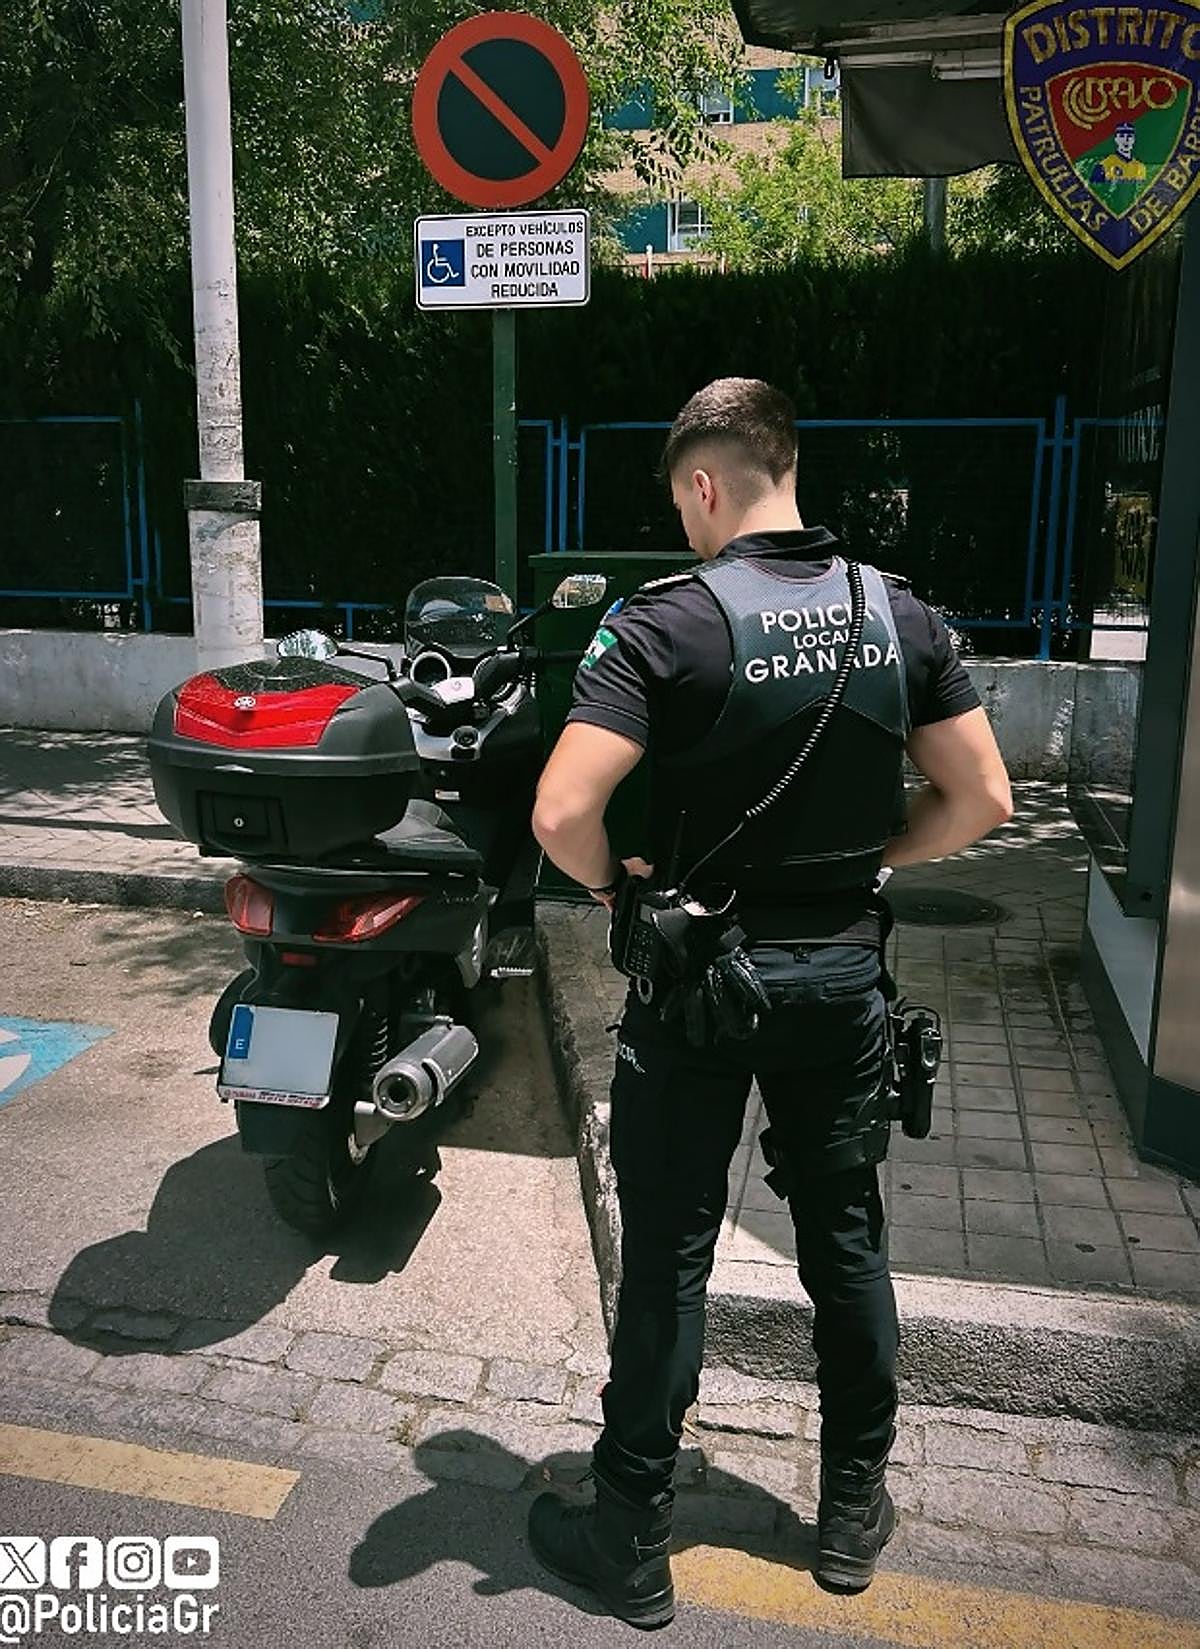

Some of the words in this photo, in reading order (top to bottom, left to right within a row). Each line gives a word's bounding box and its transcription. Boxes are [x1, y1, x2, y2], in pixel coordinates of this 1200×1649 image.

[465, 223, 516, 237] EXCEPTO
[519, 219, 584, 236] VEHÍCULOS
[477, 243, 495, 258] DE
[500, 239, 575, 257] PERSONAS
[471, 264, 499, 279] CON
[504, 260, 580, 278] MOVILIDAD
[490, 282, 559, 299] REDUCIDA
[760, 601, 874, 634] POLICI
[744, 642, 900, 684] GRANDA
[235, 1039, 245, 1050] E
